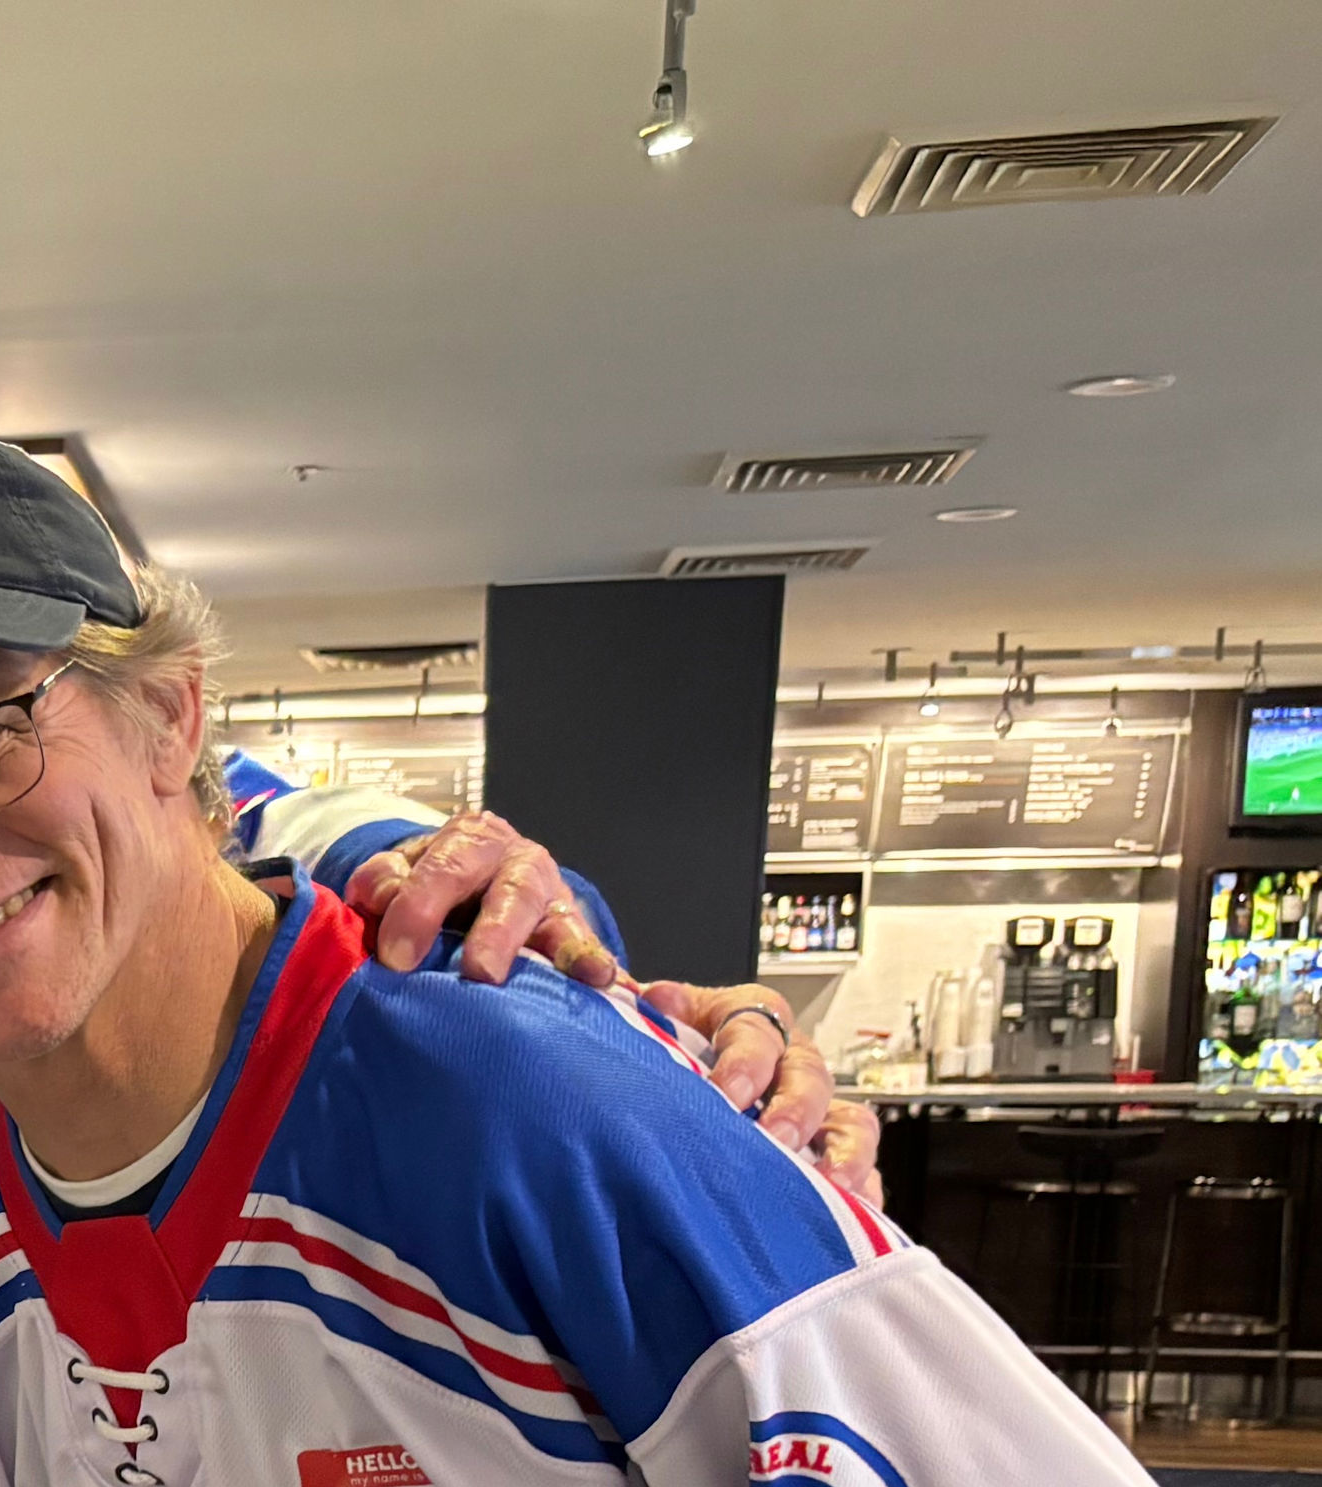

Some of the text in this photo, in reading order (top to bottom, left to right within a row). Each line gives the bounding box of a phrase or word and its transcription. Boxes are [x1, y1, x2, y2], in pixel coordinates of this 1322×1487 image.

[345, 1451, 418, 1475] HELLO
[350, 1472, 424, 1487] my name is
